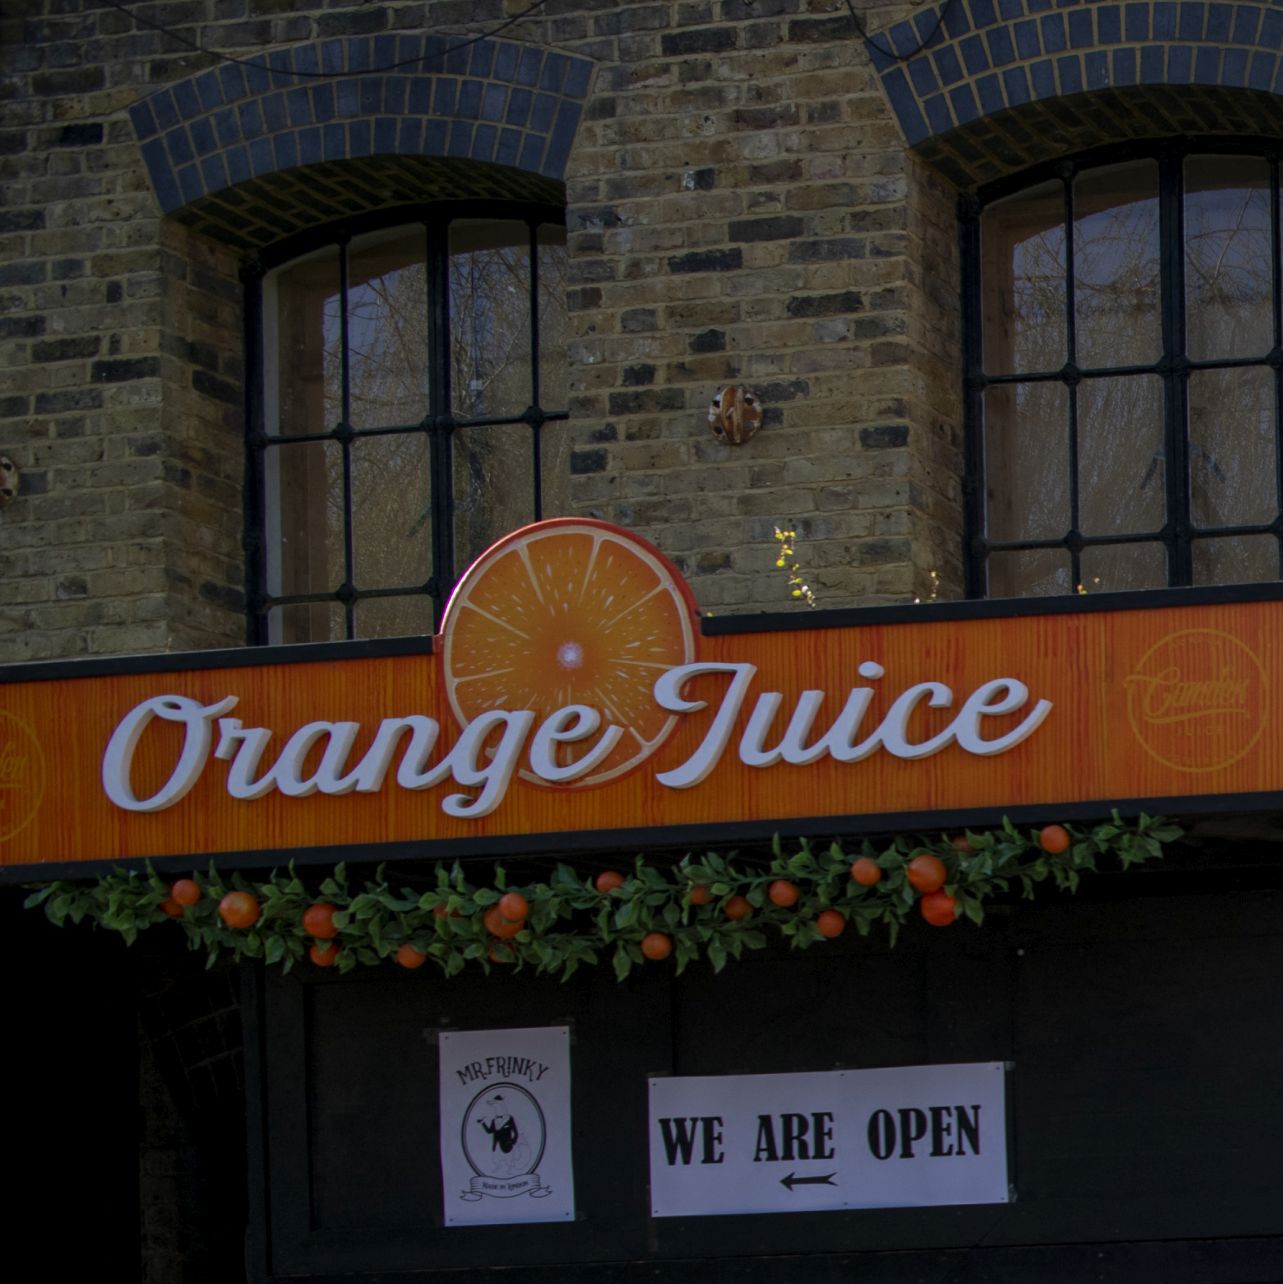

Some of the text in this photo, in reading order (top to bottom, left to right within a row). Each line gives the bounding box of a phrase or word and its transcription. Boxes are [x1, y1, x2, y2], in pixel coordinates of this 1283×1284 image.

[100, 661, 1052, 818] Orange Juice
[659, 1104, 982, 1167] WE ARE OPEN
